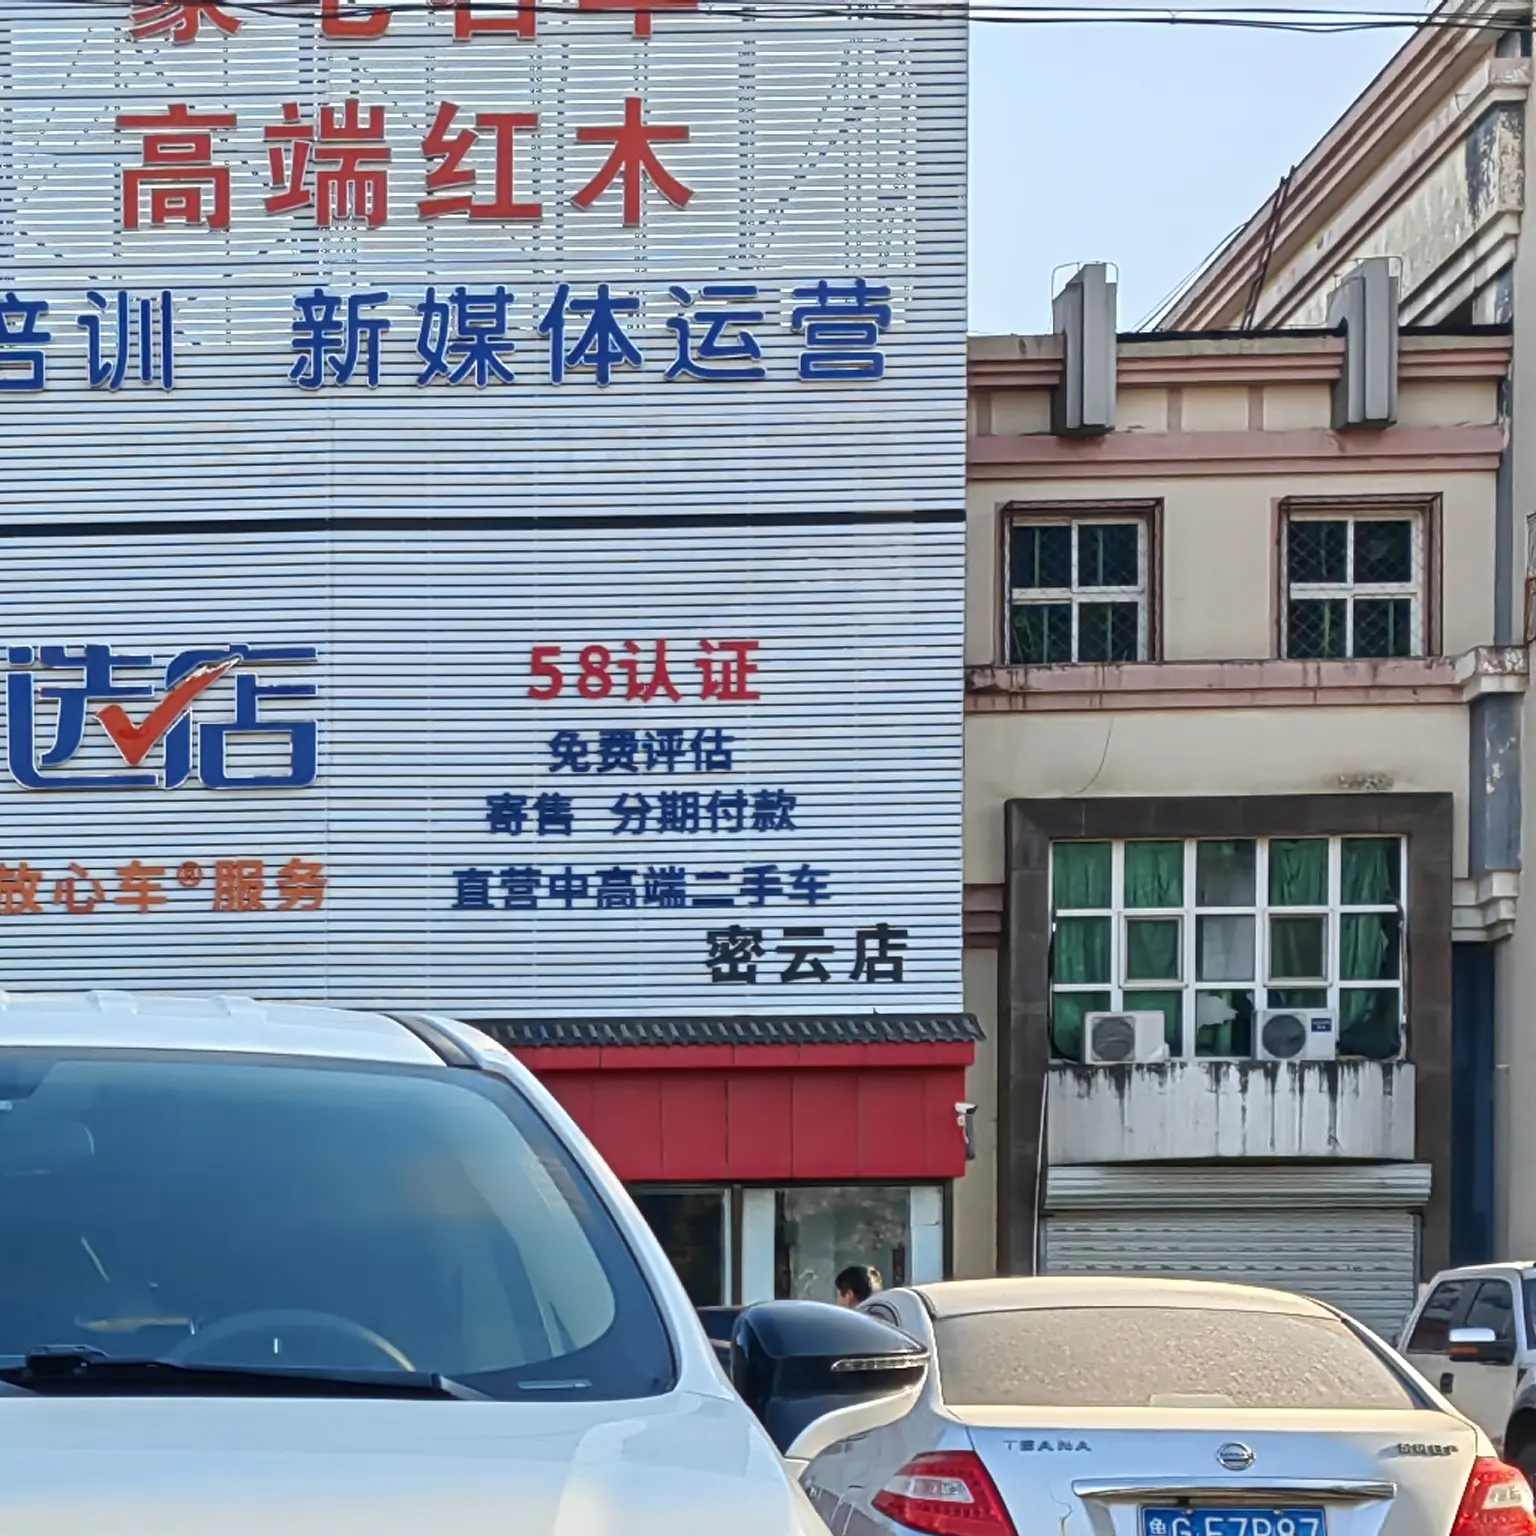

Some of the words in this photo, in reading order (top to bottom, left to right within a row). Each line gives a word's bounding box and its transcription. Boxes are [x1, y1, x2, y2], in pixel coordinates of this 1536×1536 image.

[115, 97, 695, 231] 高端红木
[288, 277, 893, 390] 新媒体运营
[528, 638, 762, 703] 58认证
[548, 728, 736, 774] 免费评估
[486, 790, 576, 837] 寄售
[610, 788, 798, 836] 分期付款
[452, 863, 832, 912] 直营中高端二手车
[705, 922, 909, 985] 密云店
[1003, 1439, 1092, 1452] TEANA
